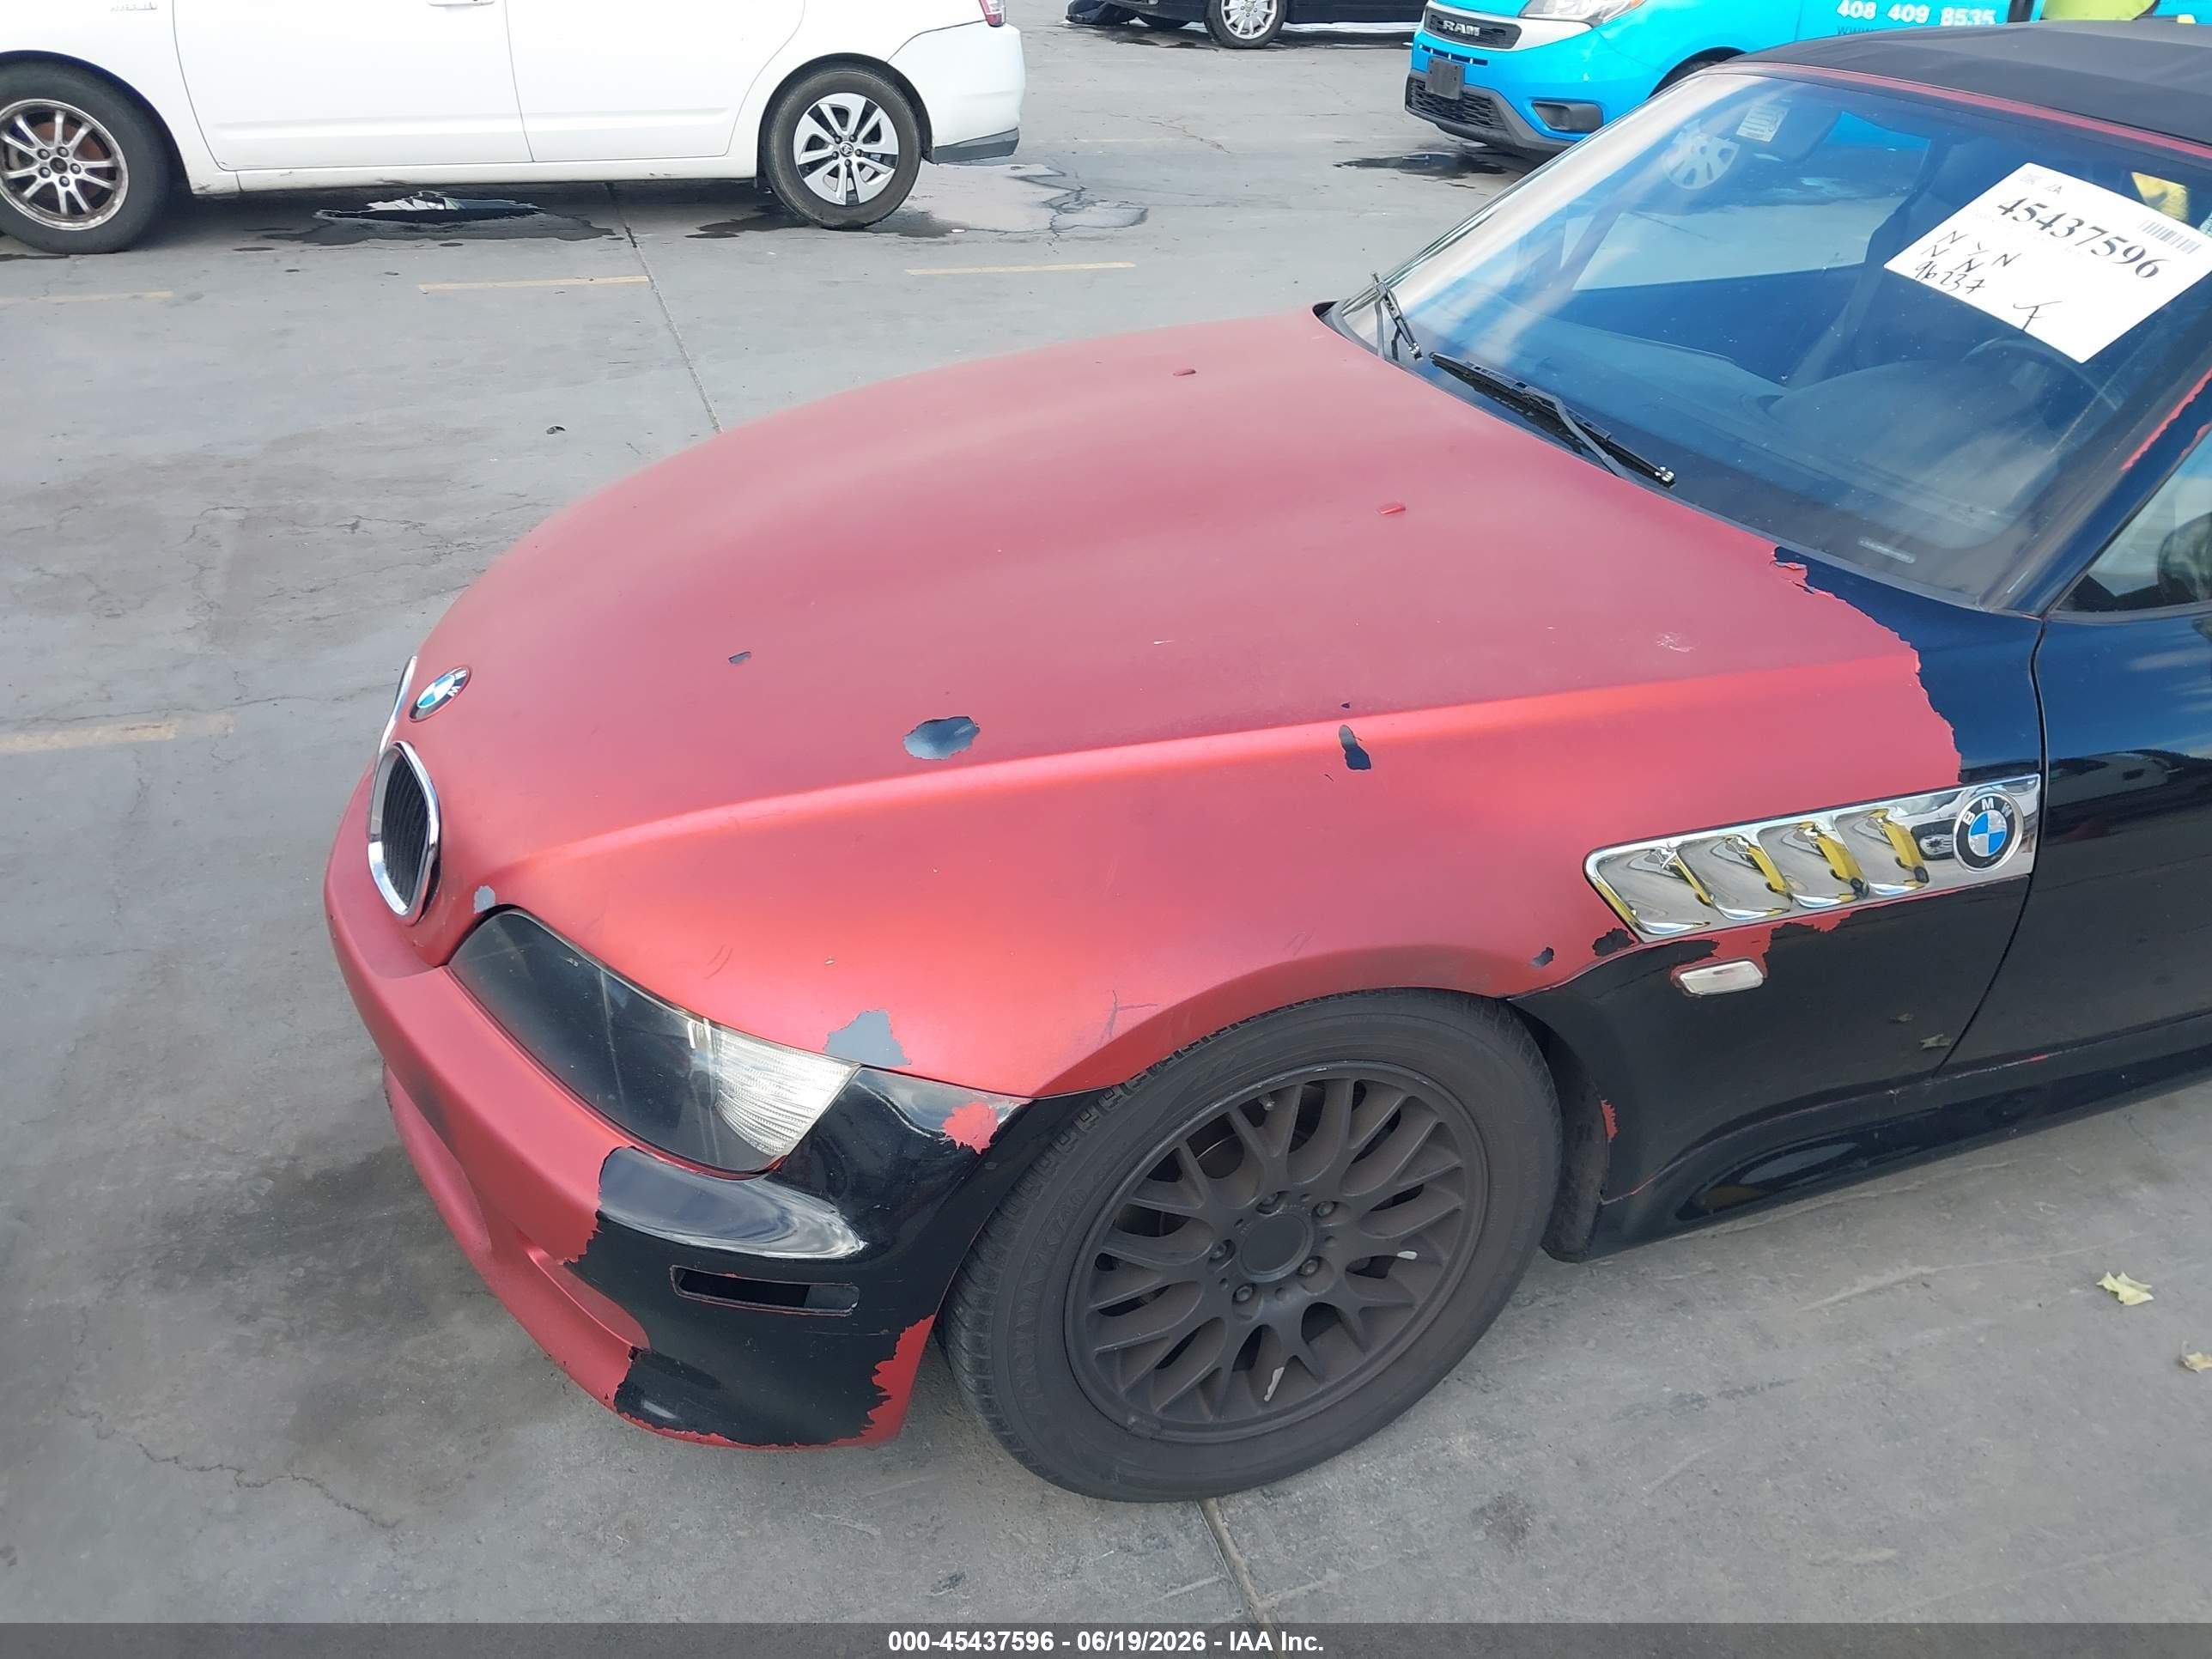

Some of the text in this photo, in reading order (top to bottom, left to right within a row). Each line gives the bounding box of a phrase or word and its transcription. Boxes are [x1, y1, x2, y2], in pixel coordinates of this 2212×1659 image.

[1836, 0, 1996, 26] 408 409 8535
[1442, 20, 1480, 36] RAM
[1996, 198, 2171, 278] 45437596
[1962, 797, 2013, 825] BMW
